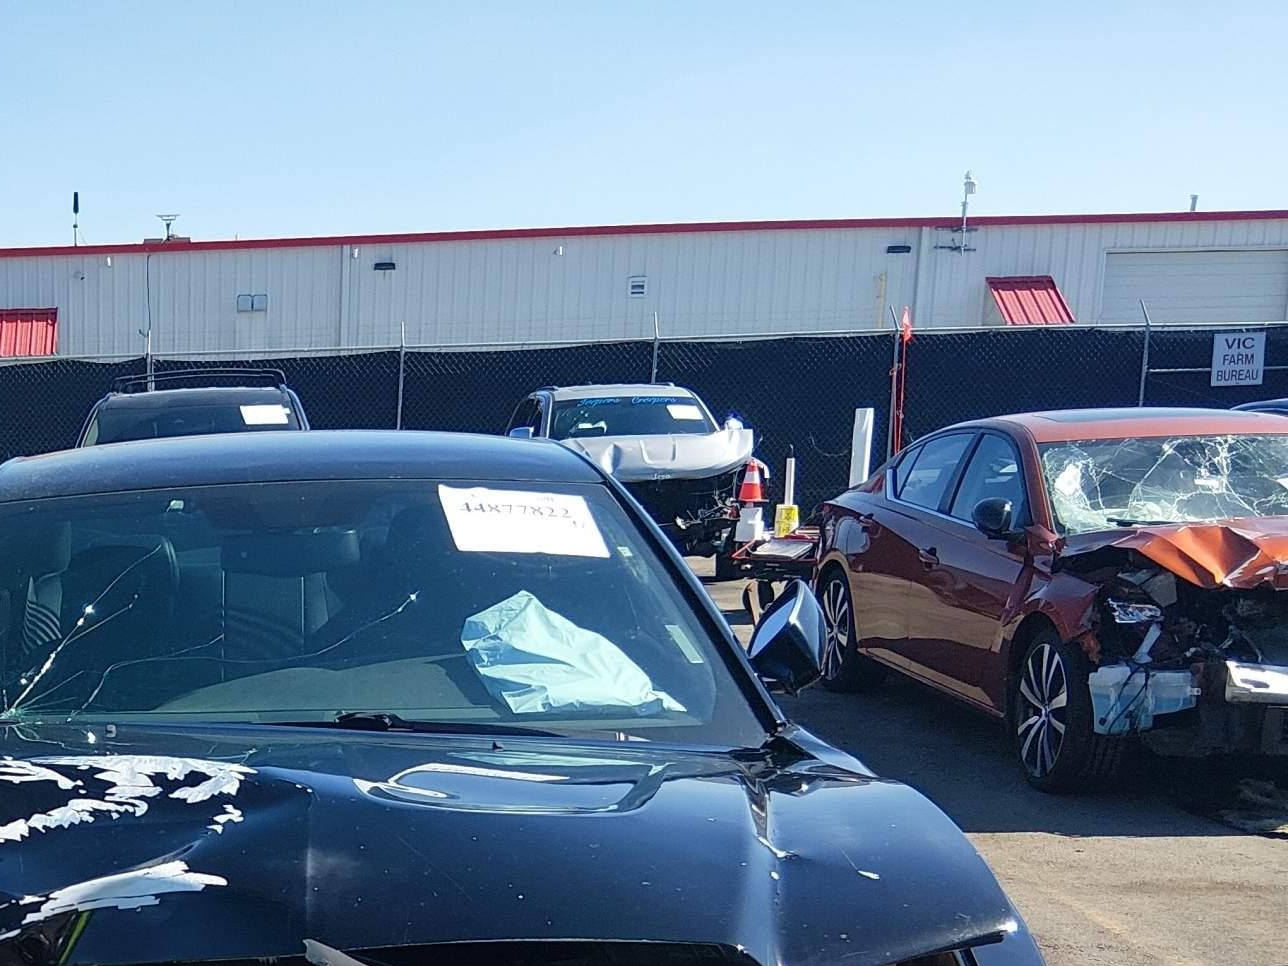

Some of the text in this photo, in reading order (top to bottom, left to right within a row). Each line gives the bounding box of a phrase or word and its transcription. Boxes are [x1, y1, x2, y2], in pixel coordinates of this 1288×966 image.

[1224, 337, 1255, 349] VIC
[1222, 353, 1255, 366] FARM
[1216, 368, 1259, 382] BUREAU
[459, 501, 573, 519] 44877822
